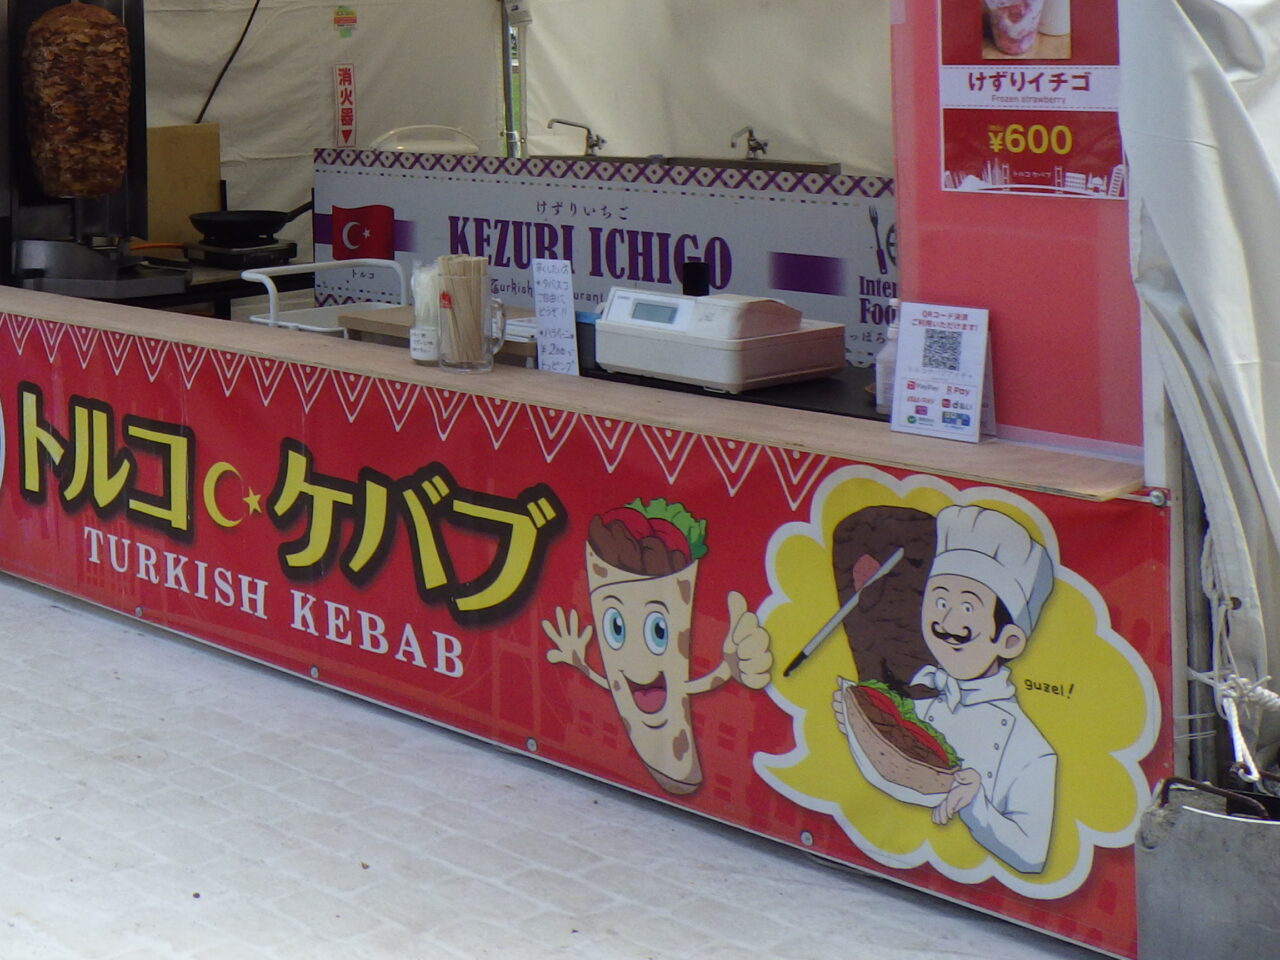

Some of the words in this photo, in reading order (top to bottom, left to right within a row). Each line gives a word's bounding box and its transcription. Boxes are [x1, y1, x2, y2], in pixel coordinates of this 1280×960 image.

[338, 67, 354, 127] 消火器
[968, 71, 1092, 93] けずりイチゴ
[988, 123, 1073, 155] ¥600
[536, 200, 629, 220] けずりいちご
[448, 215, 576, 275] KEZURI
[588, 225, 733, 290] ICHIGO
[20, 387, 191, 533] トルコ
[271, 447, 560, 615] ケバブ
[84, 525, 269, 620] TURKISH
[290, 588, 465, 680] KEBAB
